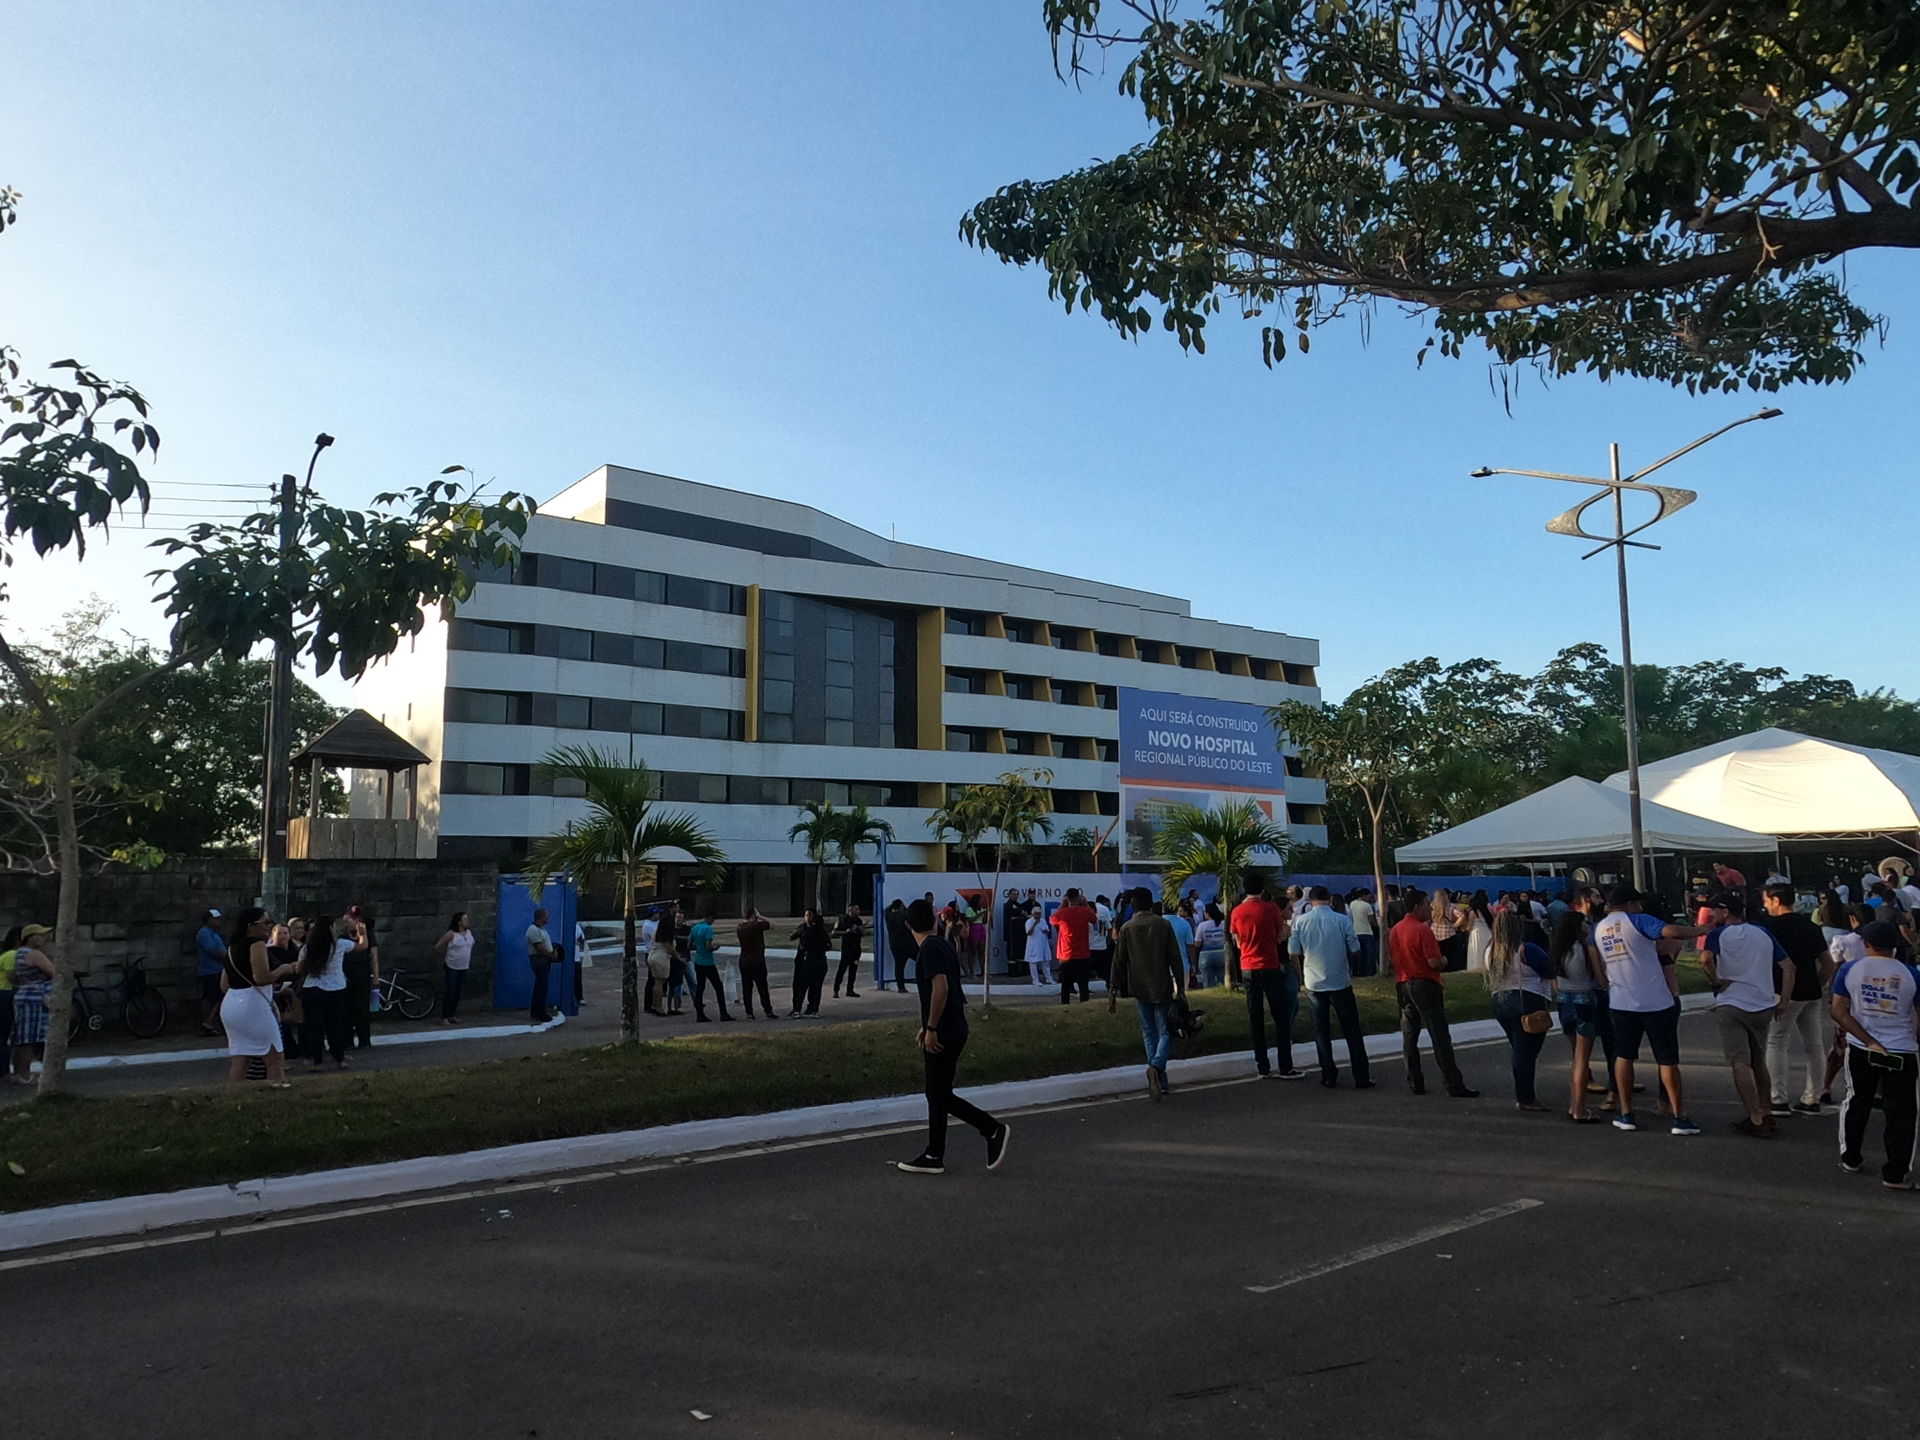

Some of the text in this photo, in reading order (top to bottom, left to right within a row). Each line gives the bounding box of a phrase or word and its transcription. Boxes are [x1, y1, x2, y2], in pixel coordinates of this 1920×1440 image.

[1139, 707, 1259, 734] AQUI SERÁ CONSTRUÍDO
[1148, 730, 1258, 756] NOVO HOSPITAL
[1134, 750, 1273, 775] REGIONAL PÚBLICO DO LESTE
[1002, 887, 1062, 898] GVRNO
